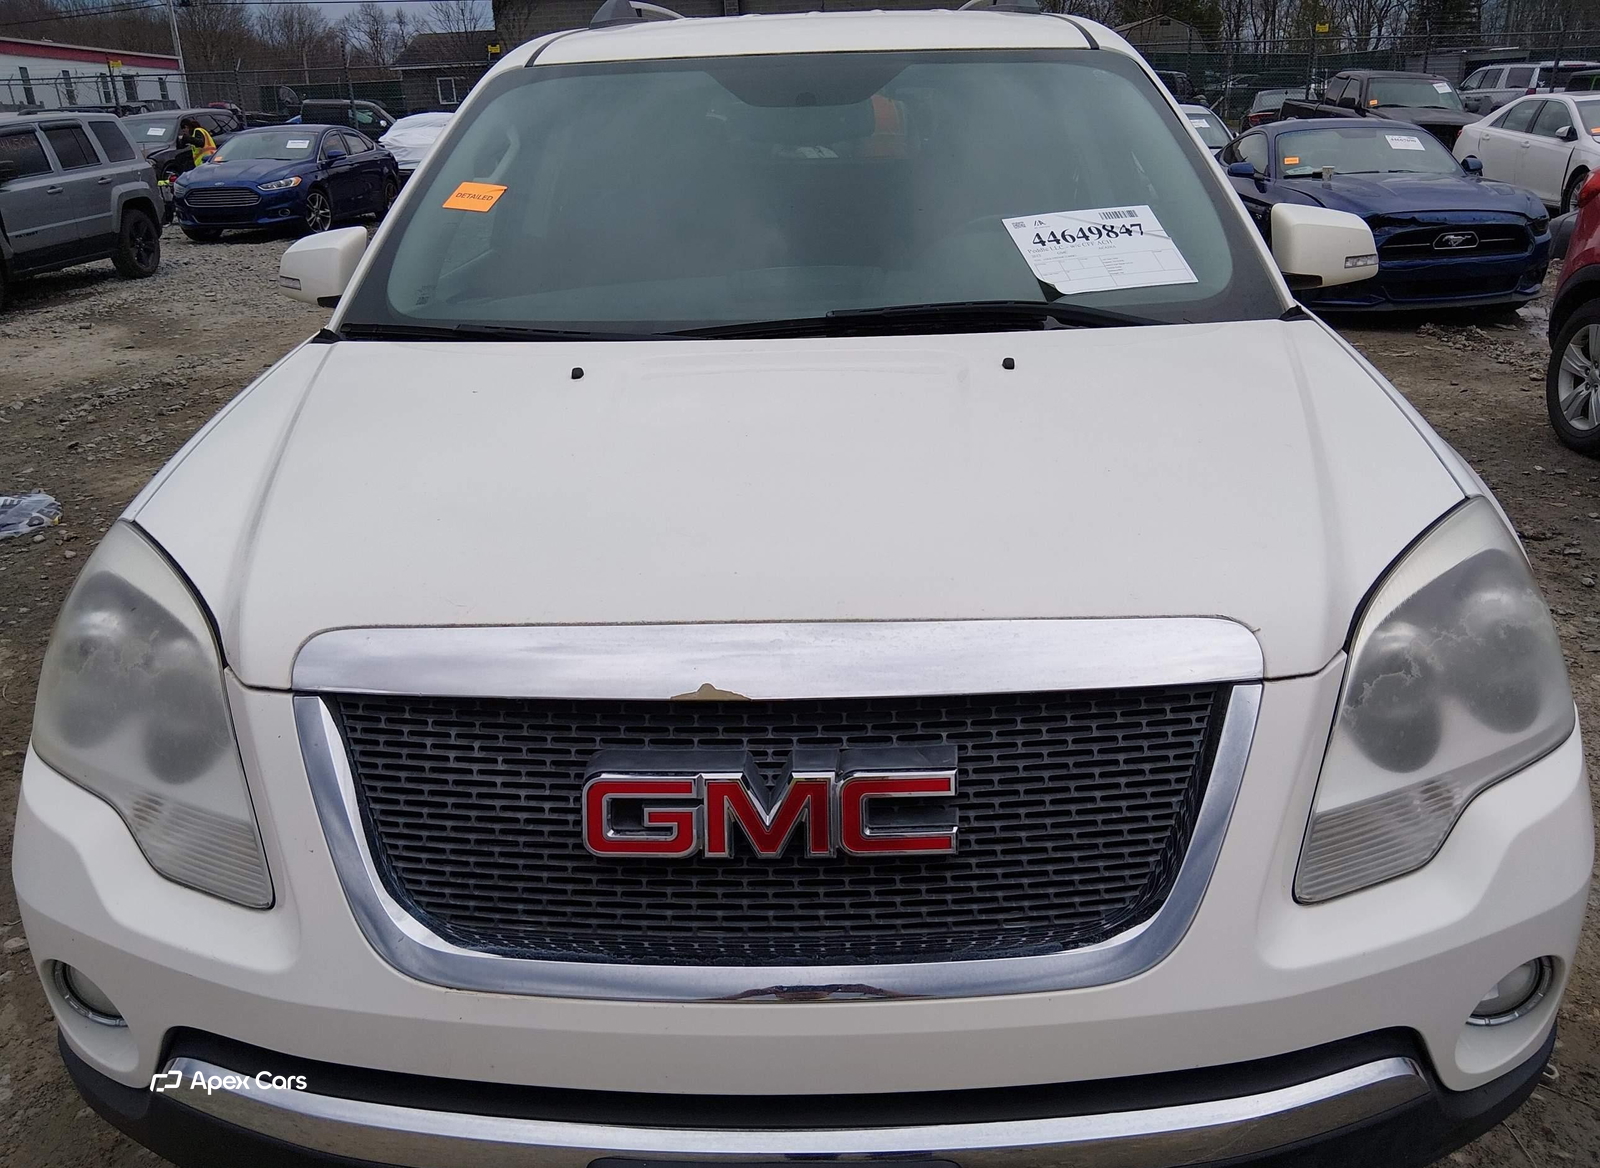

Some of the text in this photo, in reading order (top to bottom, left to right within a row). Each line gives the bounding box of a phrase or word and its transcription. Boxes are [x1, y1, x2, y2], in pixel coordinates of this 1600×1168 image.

[455, 192, 494, 201] DETAILED
[1032, 223, 1144, 247] 44649847
[582, 769, 958, 860] GMC
